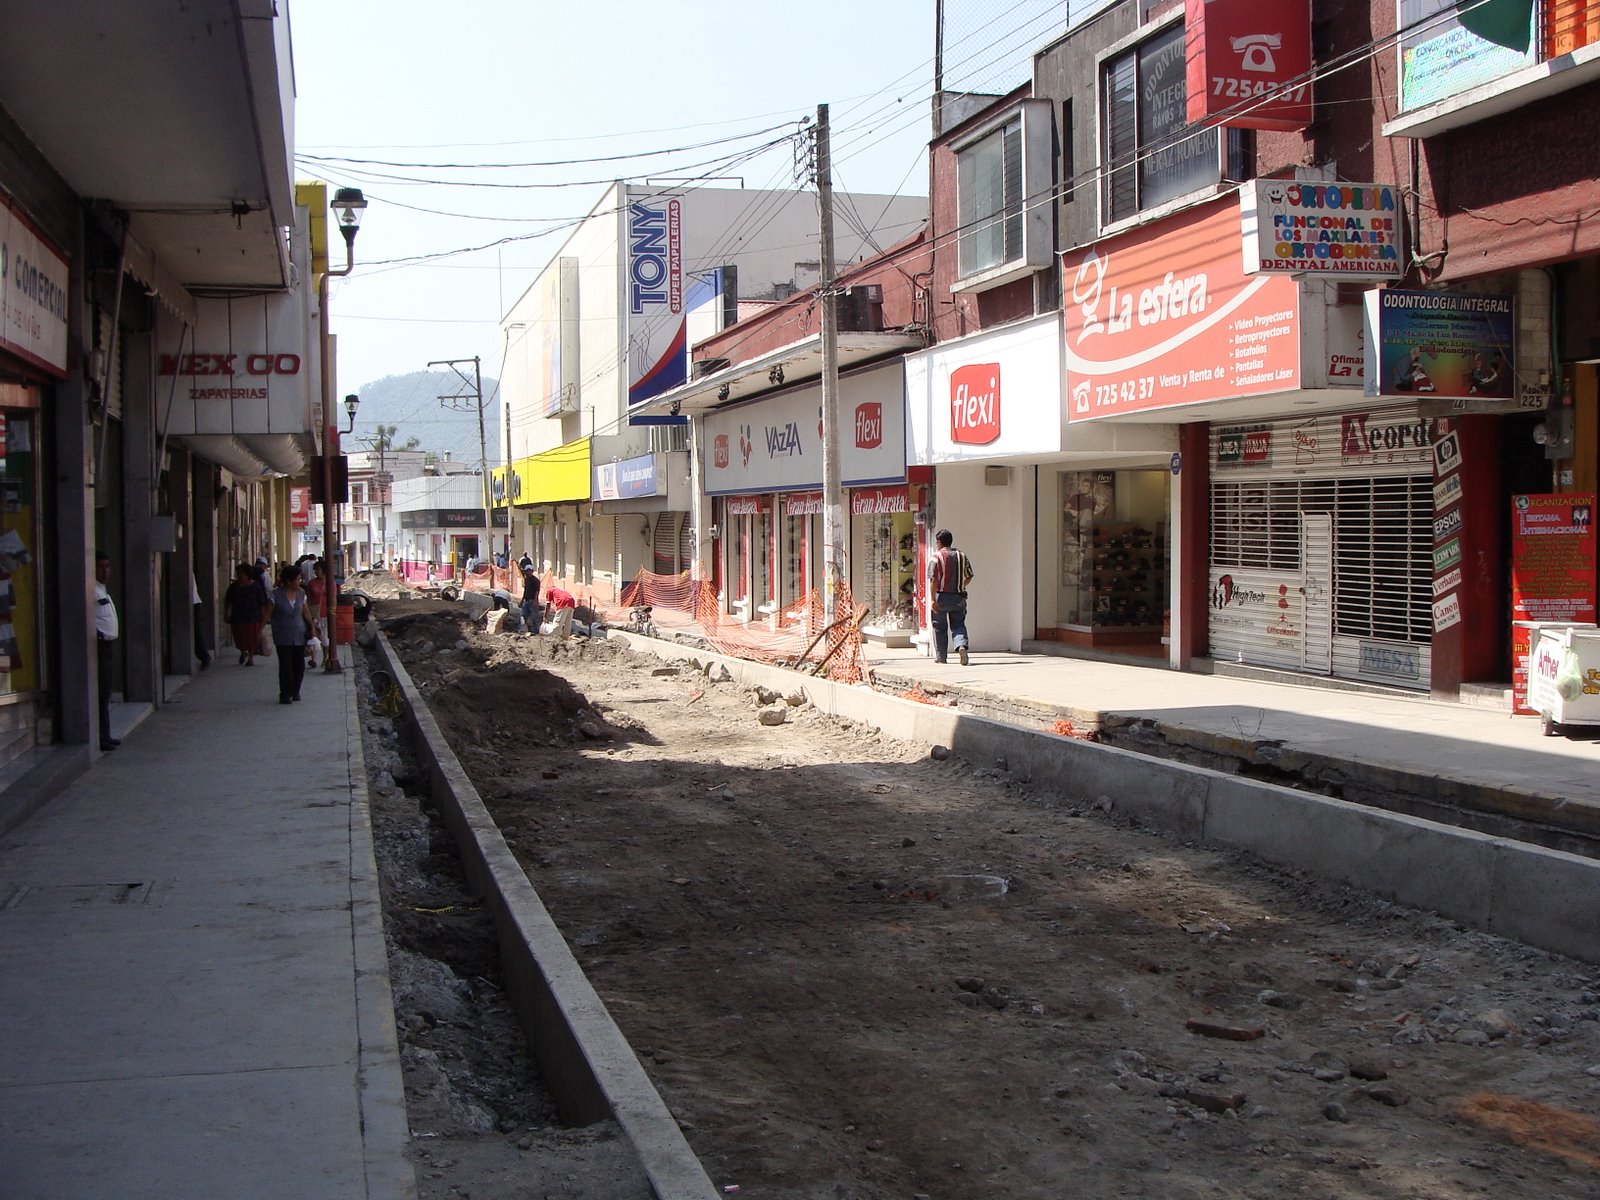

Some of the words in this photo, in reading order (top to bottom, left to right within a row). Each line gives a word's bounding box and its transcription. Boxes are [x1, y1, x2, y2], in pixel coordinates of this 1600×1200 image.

[1145, 42, 1186, 101] ODONTOL
[1152, 79, 1187, 112] INTEGR
[1212, 77, 1306, 103] 7254237
[1177, 129, 1217, 163] ROMERO
[1286, 184, 1395, 212] ORTOPEDIA
[1274, 215, 1365, 230] FUNCIONAL
[1371, 218, 1393, 231] DE
[670, 202, 680, 270] PAPELERIAS
[1275, 229, 1302, 242] LOS
[1306, 229, 1385, 244] MAXILARES
[1387, 232, 1395, 244] Y
[630, 198, 668, 314] TONY
[1274, 242, 1397, 260] ORTODONCIA
[1261, 260, 1330, 270] DENTAL
[1333, 261, 1399, 272] AMERICANA
[15, 254, 67, 325] COMERCIAL
[671, 273, 680, 311] SUPER
[1108, 286, 1134, 335] La
[1138, 272, 1208, 327] esfera
[1383, 293, 1457, 311] ODONTOLOGIA
[1459, 297, 1510, 313] INTEGRAL
[1234, 319, 1254, 331] Video
[1254, 310, 1294, 327] Proyectores
[1234, 325, 1291, 345] Retroproyectores
[1234, 344, 1268, 359] Rotafolios
[1159, 374, 1181, 388] Venta
[1182, 374, 1188, 388] y
[1189, 368, 1213, 383] Renta
[1214, 365, 1226, 379] de
[1235, 360, 1264, 373] Pantallas
[1328, 364, 1352, 377] La
[1235, 372, 1275, 387] Señaladores
[189, 388, 269, 400] ZAPATERIAS
[1096, 384, 1118, 407] 725
[1120, 380, 1136, 403] 42
[1138, 376, 1155, 400] 37
[1522, 396, 1543, 408] 225
[953, 379, 996, 429] flexi
[856, 407, 881, 443] flexi
[1343, 451, 1426, 465] MUEBLE
[786, 493, 805, 515] Gran
[804, 492, 825, 514] Barat
[852, 492, 875, 515] Gran
[875, 490, 908, 513] Barata
[1434, 509, 1461, 535] EPSON
[1433, 543, 1460, 564] LEXMARK
[1433, 571, 1461, 594] Verbatim
[1433, 602, 1459, 620] Canon
